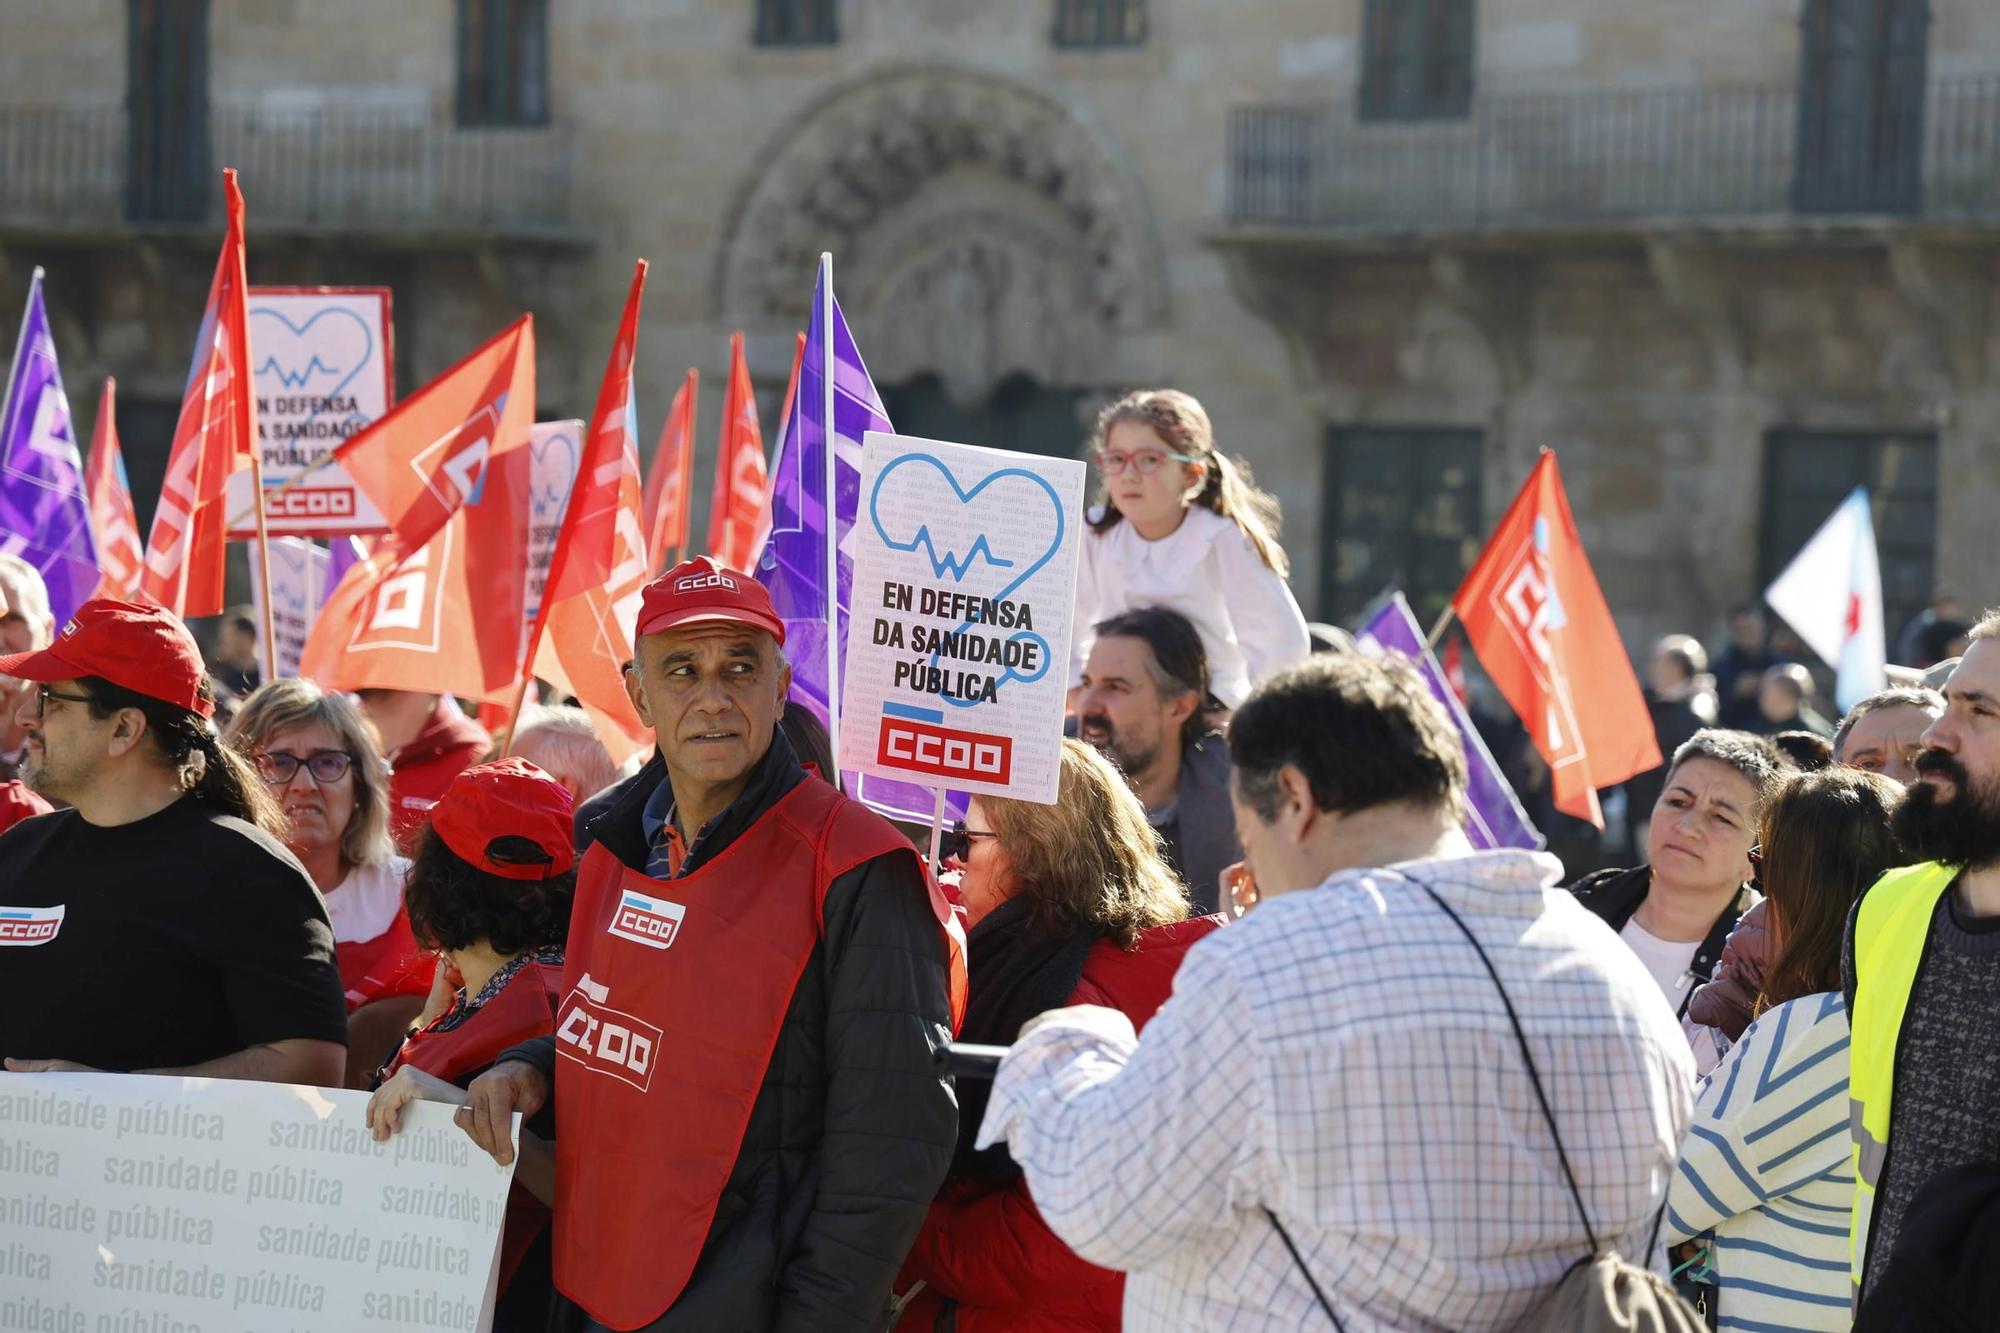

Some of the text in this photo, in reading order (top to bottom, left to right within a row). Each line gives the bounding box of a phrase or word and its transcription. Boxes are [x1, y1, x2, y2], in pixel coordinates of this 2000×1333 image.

[275, 397, 359, 415] DEFENSA
[678, 574, 735, 591] CCOO
[883, 581, 913, 612] EN
[919, 587, 1033, 631] DEFENSA
[872, 617, 1038, 671] DA SANIDADE
[894, 658, 998, 704] PÚBLICA
[887, 728, 1002, 775] CCOO
[0, 923, 54, 937] CCOO
[620, 911, 673, 939] CCOO
[557, 1006, 652, 1076] CCOO
[0, 1090, 106, 1130] anidade
[116, 1099, 225, 1141] pública
[393, 1126, 469, 1168] pública
[0, 1139, 60, 1177] blica
[104, 1153, 238, 1196] sanidade
[246, 1164, 343, 1207] pública
[380, 1182, 481, 1225] sanidade
[0, 1193, 470, 1276] nidade pública sanidade pública
[1, 1296, 86, 1333] nidade
[94, 1259, 226, 1300] sanidade
[233, 1268, 325, 1314] pública
[362, 1288, 476, 1333] sanidade
